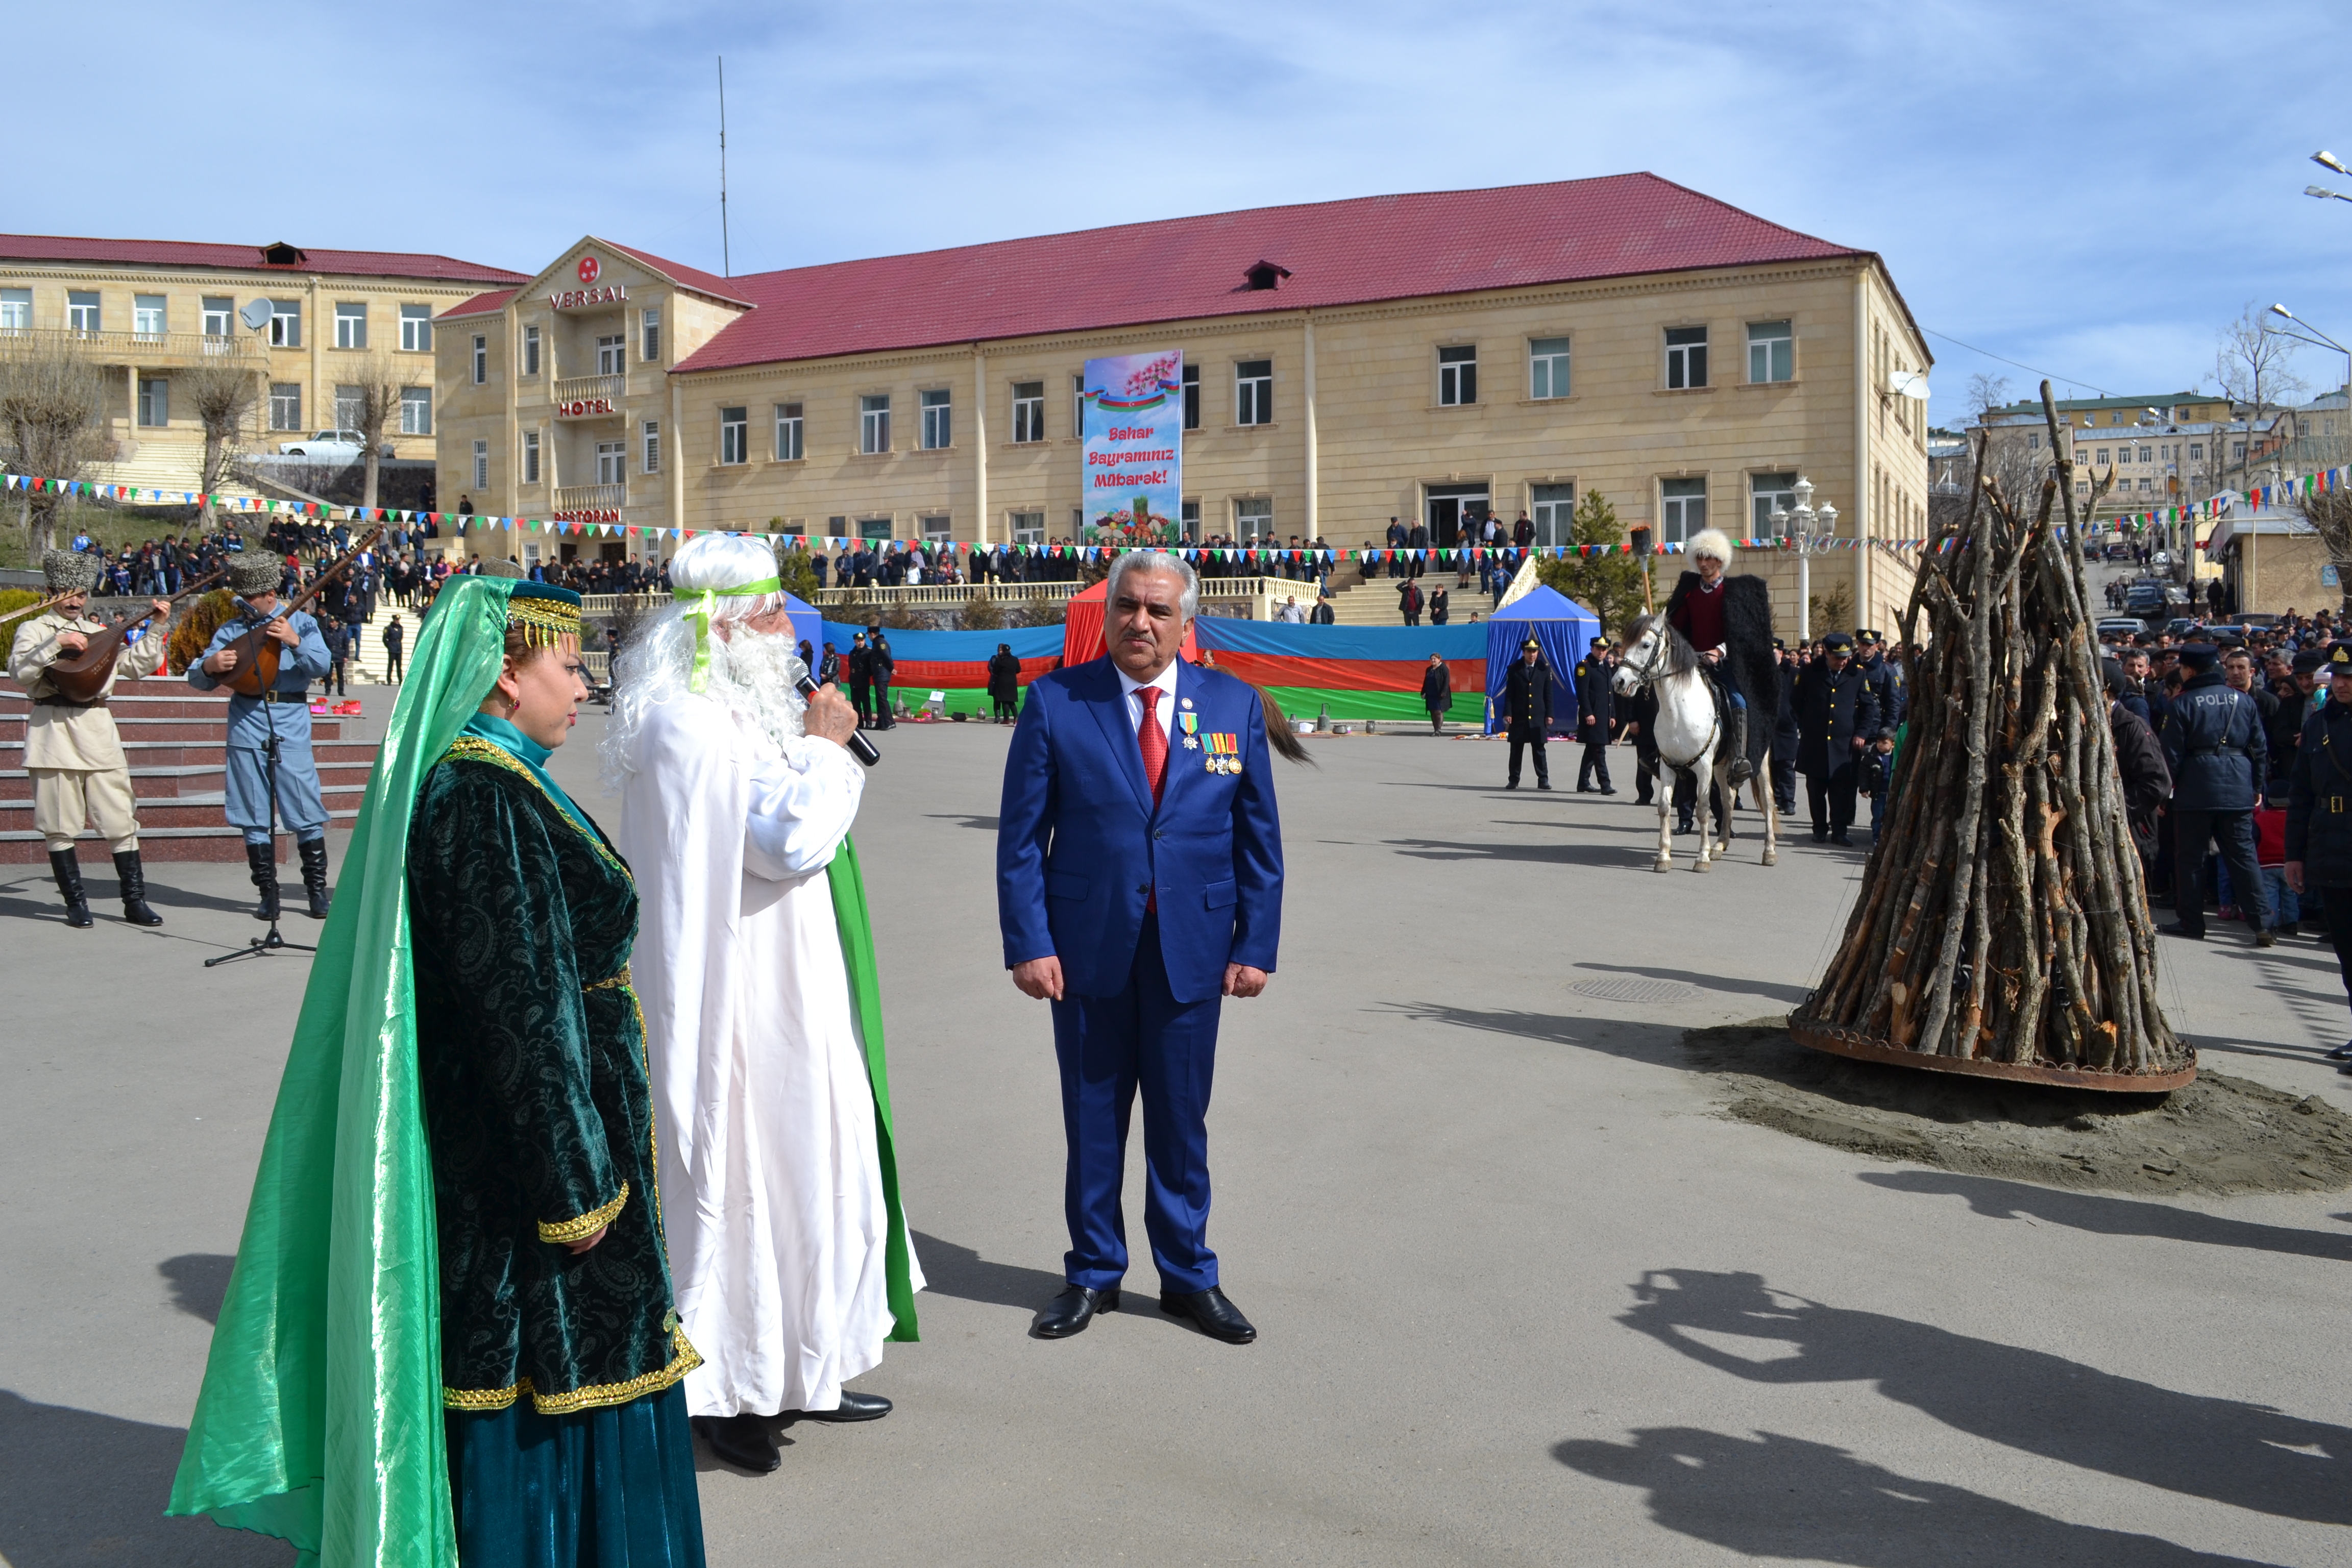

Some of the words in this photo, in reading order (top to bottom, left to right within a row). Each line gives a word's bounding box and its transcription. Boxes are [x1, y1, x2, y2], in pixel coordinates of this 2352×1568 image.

[549, 285, 629, 309] VERSAL
[560, 399, 615, 416] HOTEL
[1109, 426, 1154, 441] Bahar
[1088, 449, 1174, 467] Bayramınız
[1094, 470, 1168, 488] Mübarək!
[555, 508, 621, 526] RESTORAN
